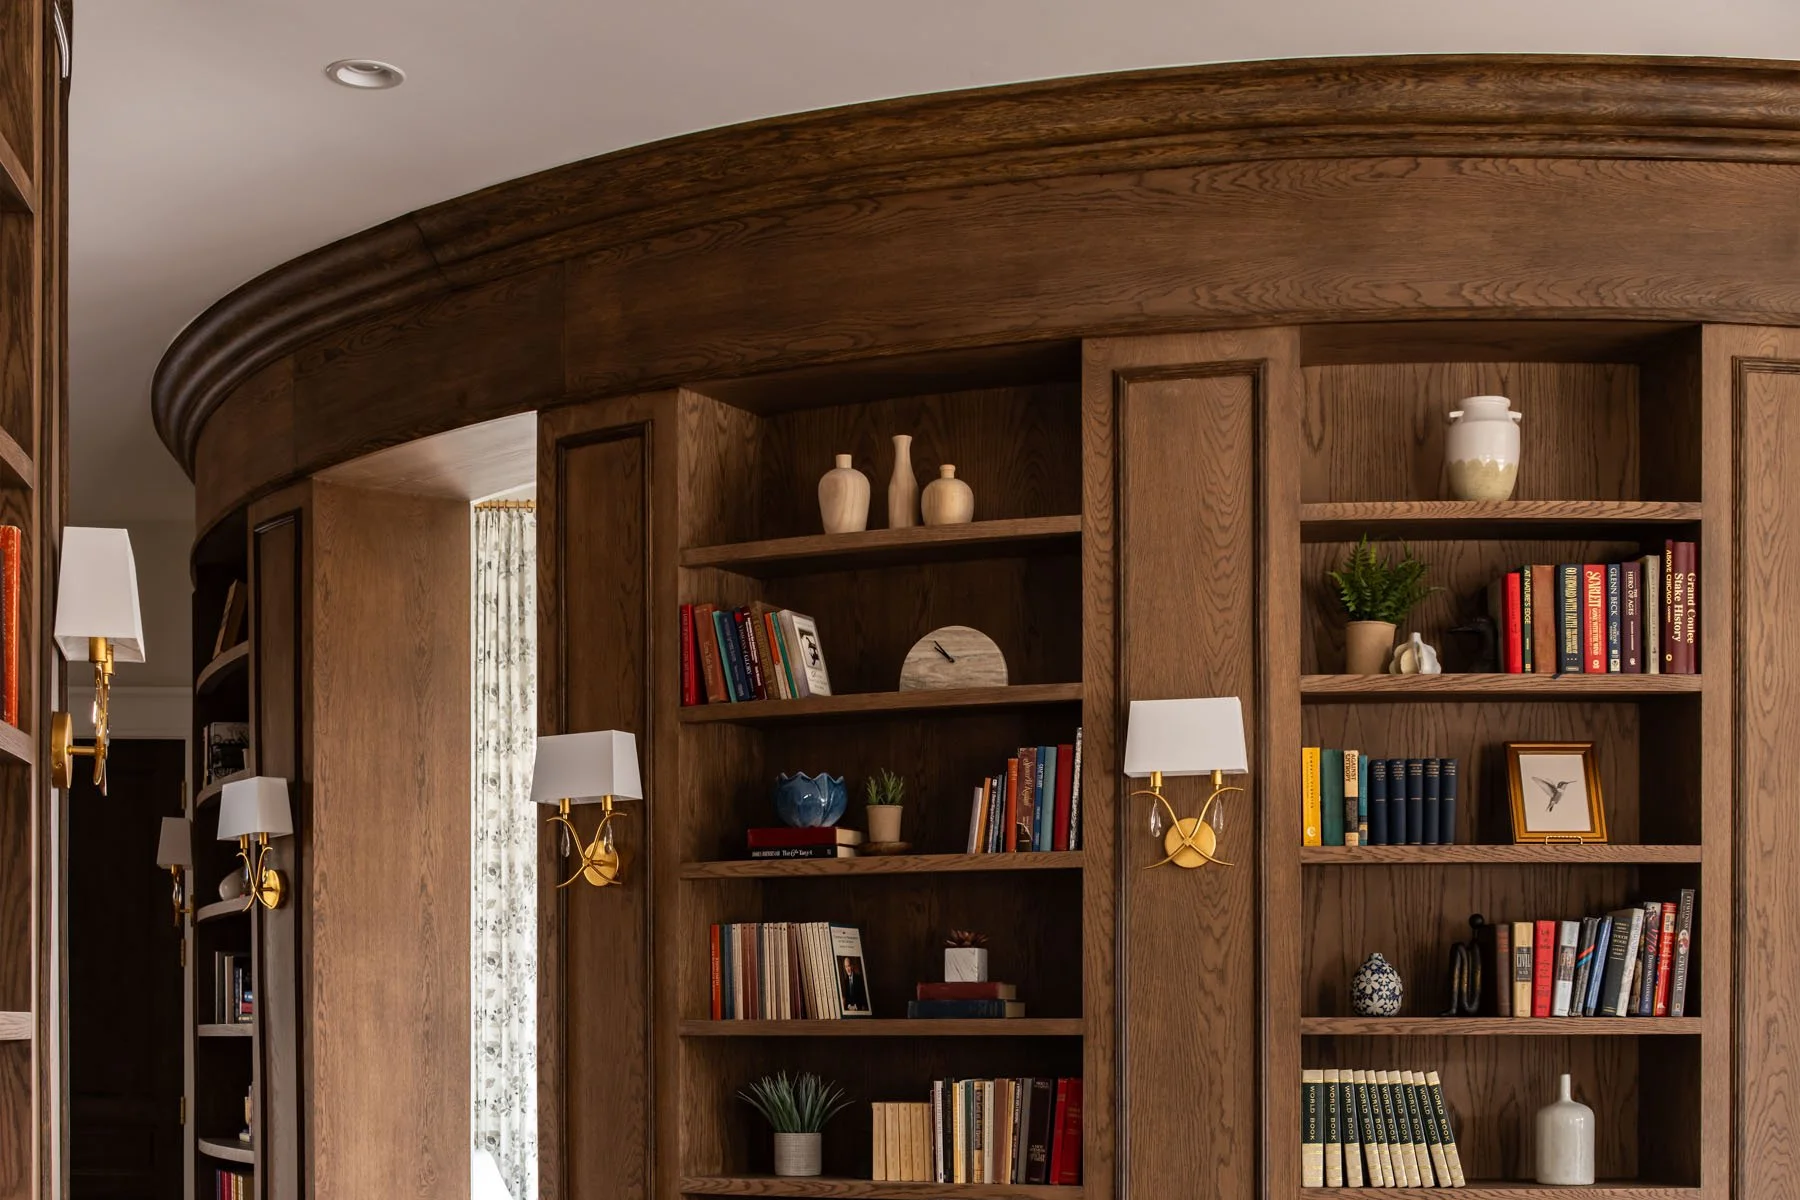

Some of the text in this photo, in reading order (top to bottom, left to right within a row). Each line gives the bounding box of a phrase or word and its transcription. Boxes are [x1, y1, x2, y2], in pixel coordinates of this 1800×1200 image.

[1565, 575, 1577, 598] FORWARD
[1565, 599, 1577, 611] WITH
[1586, 571, 1602, 608] SCARLETT
[1672, 573, 1684, 642] Stake History
[1687, 573, 1696, 643] Grand Coulee
[1565, 613, 1577, 627] FAITH
[744, 654, 752, 675] GLORY
[1684, 895, 1692, 928] EYEWITNESS
[1647, 929, 1659, 954] 1776
[1359, 1086, 1372, 1140] WORLD BOOK
[1371, 1087, 1383, 1141] WORLD BOOK
[1382, 1087, 1396, 1141] WORLD BOOK
[1395, 1087, 1408, 1141] WORLD BOOK
[1407, 1087, 1421, 1141] WORLD BOOK
[1420, 1088, 1437, 1141] WORLD BOOK
[1433, 1088, 1450, 1141] WORLD BOOK
